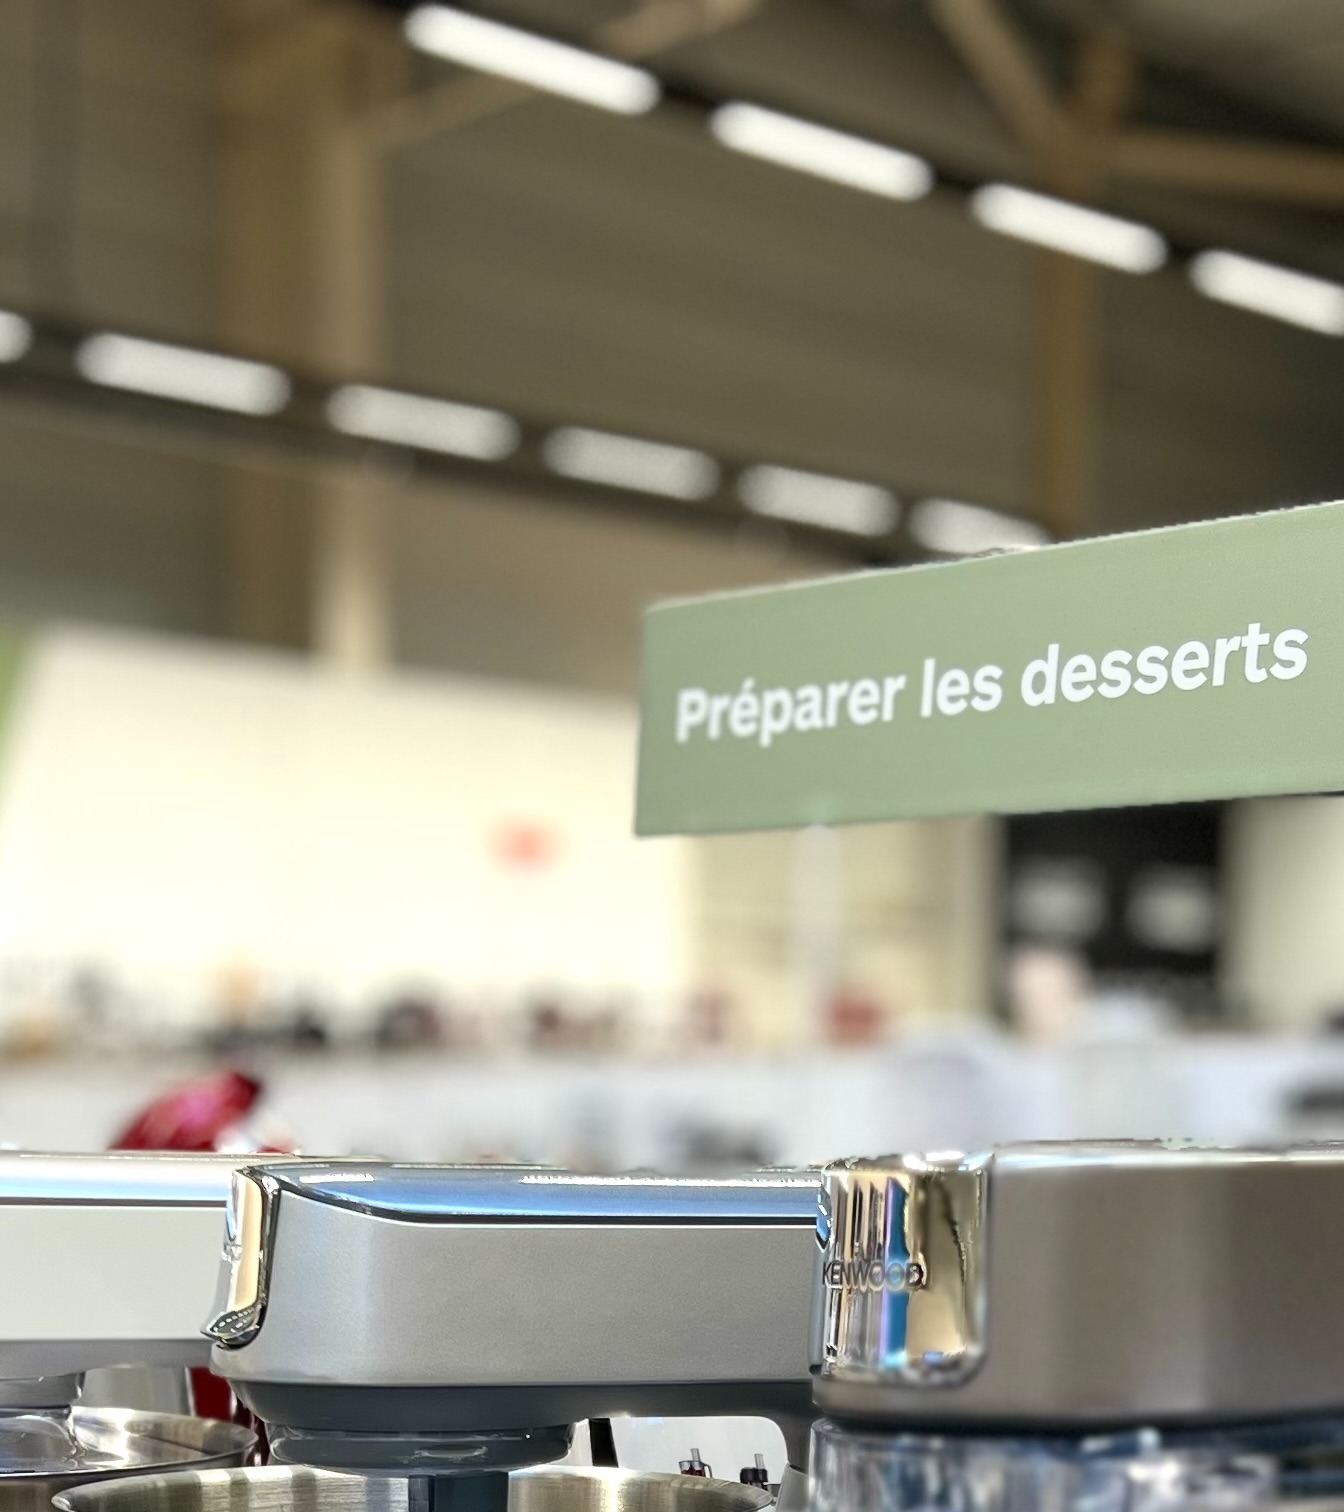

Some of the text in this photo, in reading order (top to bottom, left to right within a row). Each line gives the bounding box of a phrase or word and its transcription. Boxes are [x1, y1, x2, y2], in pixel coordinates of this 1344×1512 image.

[677, 622, 1309, 747] Préparer les desserts
